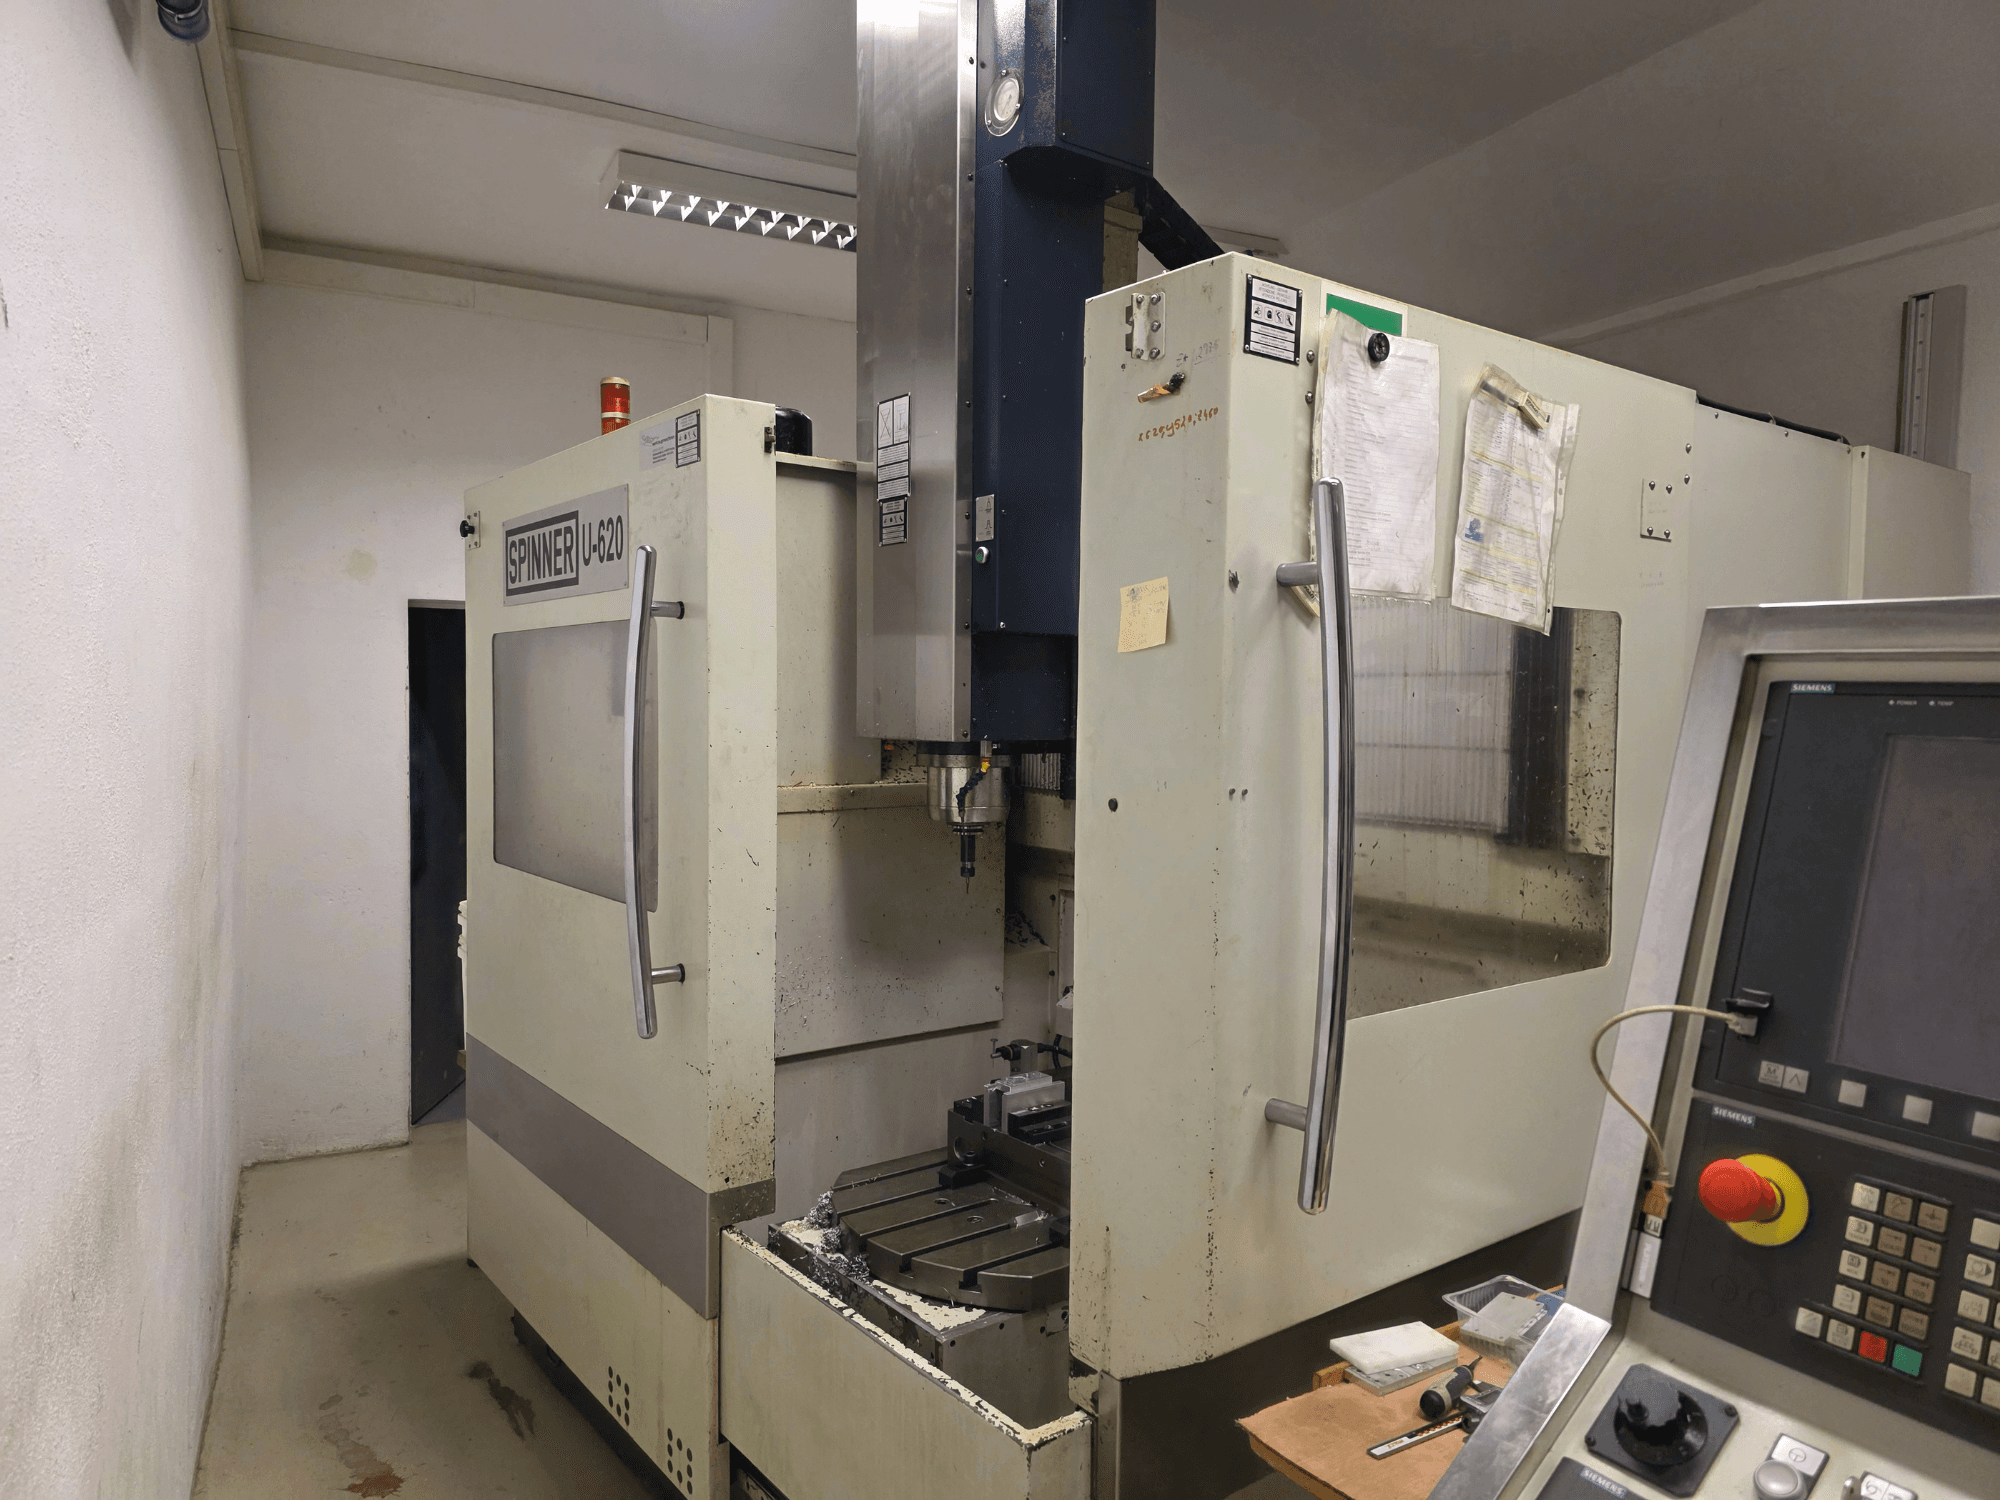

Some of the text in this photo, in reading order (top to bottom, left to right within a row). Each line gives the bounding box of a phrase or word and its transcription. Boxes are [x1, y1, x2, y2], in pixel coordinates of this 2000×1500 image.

[508, 515, 624, 585] SPINNER U-620
[1792, 683, 1833, 692] SIEMENS
[1713, 1107, 1754, 1124] SIEMENS
[1584, 1468, 1624, 1496] SIEMENS
